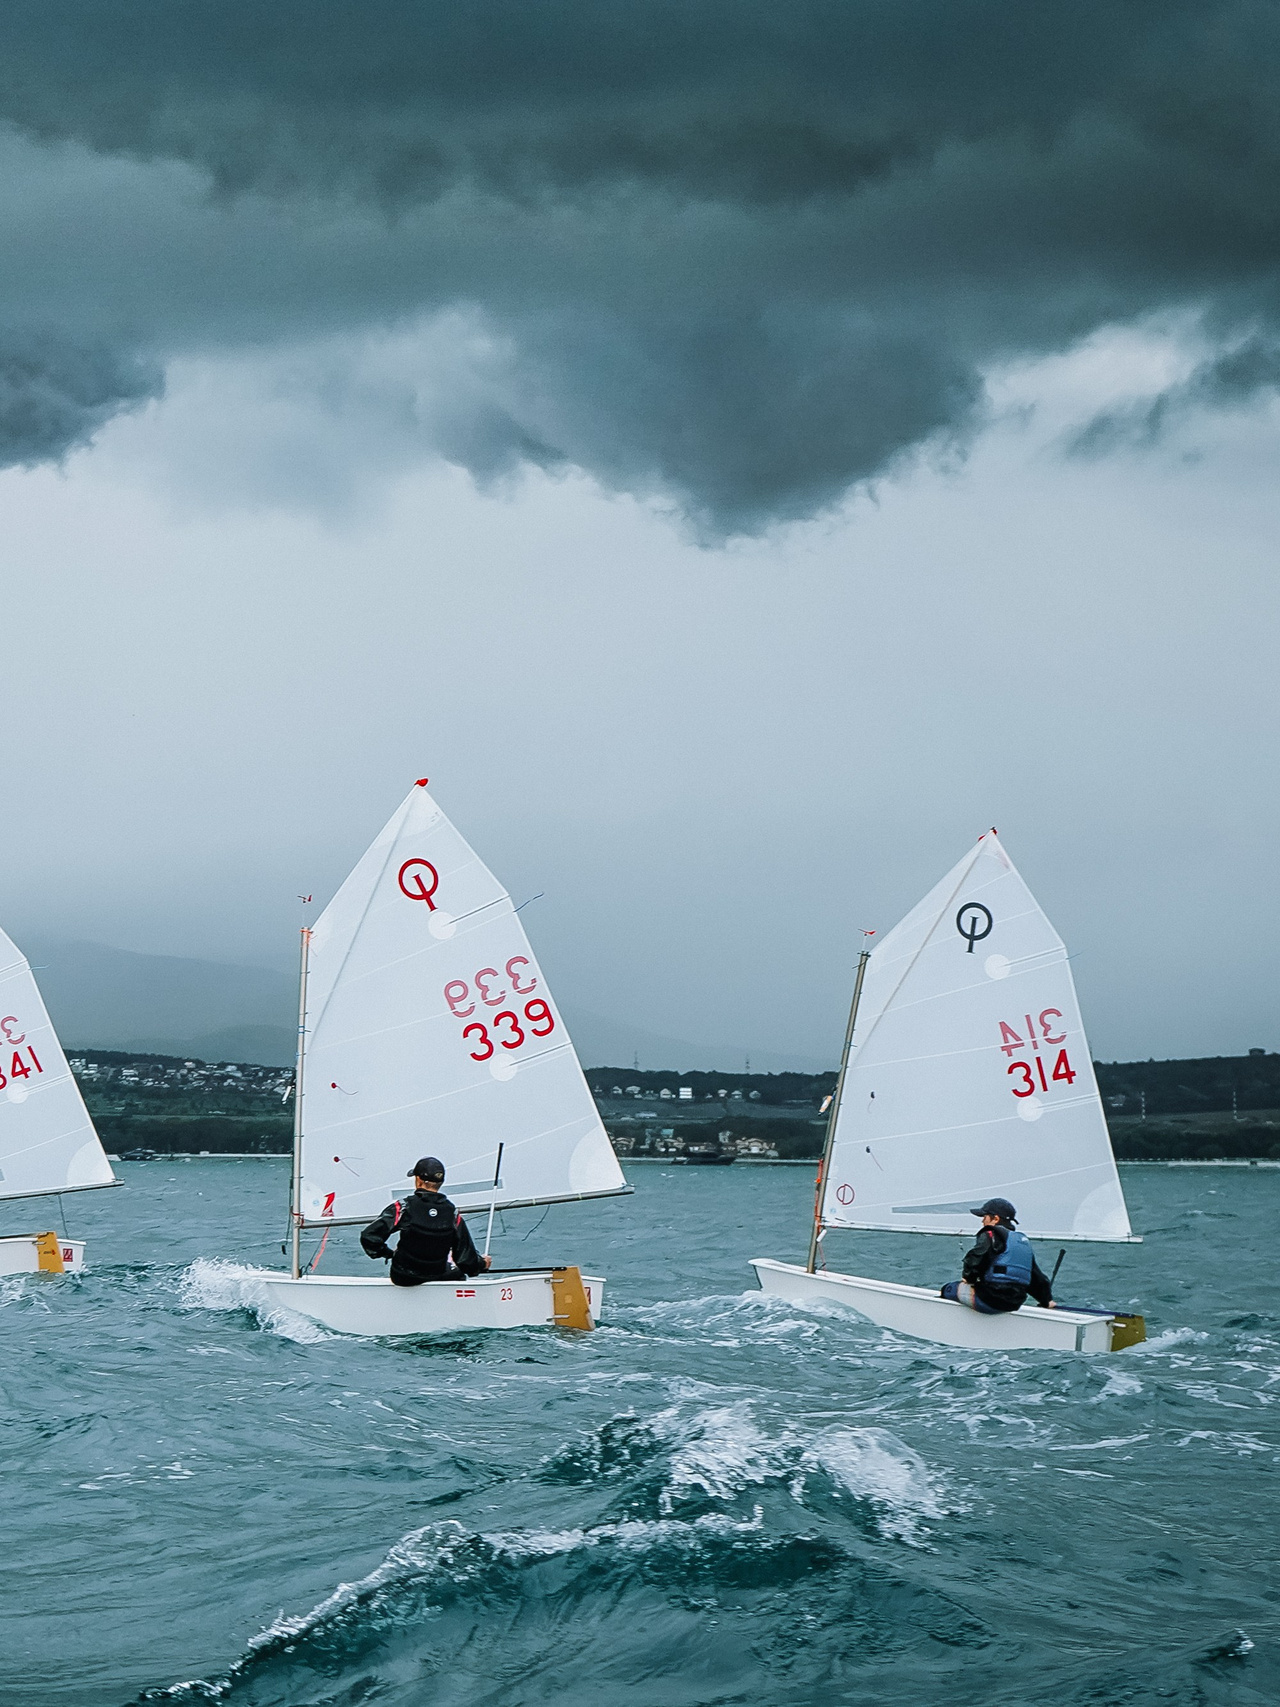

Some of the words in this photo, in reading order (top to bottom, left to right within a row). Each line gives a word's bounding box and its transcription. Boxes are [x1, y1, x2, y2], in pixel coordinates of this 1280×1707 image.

[463, 999, 554, 1061] 339
[1007, 1049, 1076, 1098] 314
[500, 1288, 513, 1301] 23
